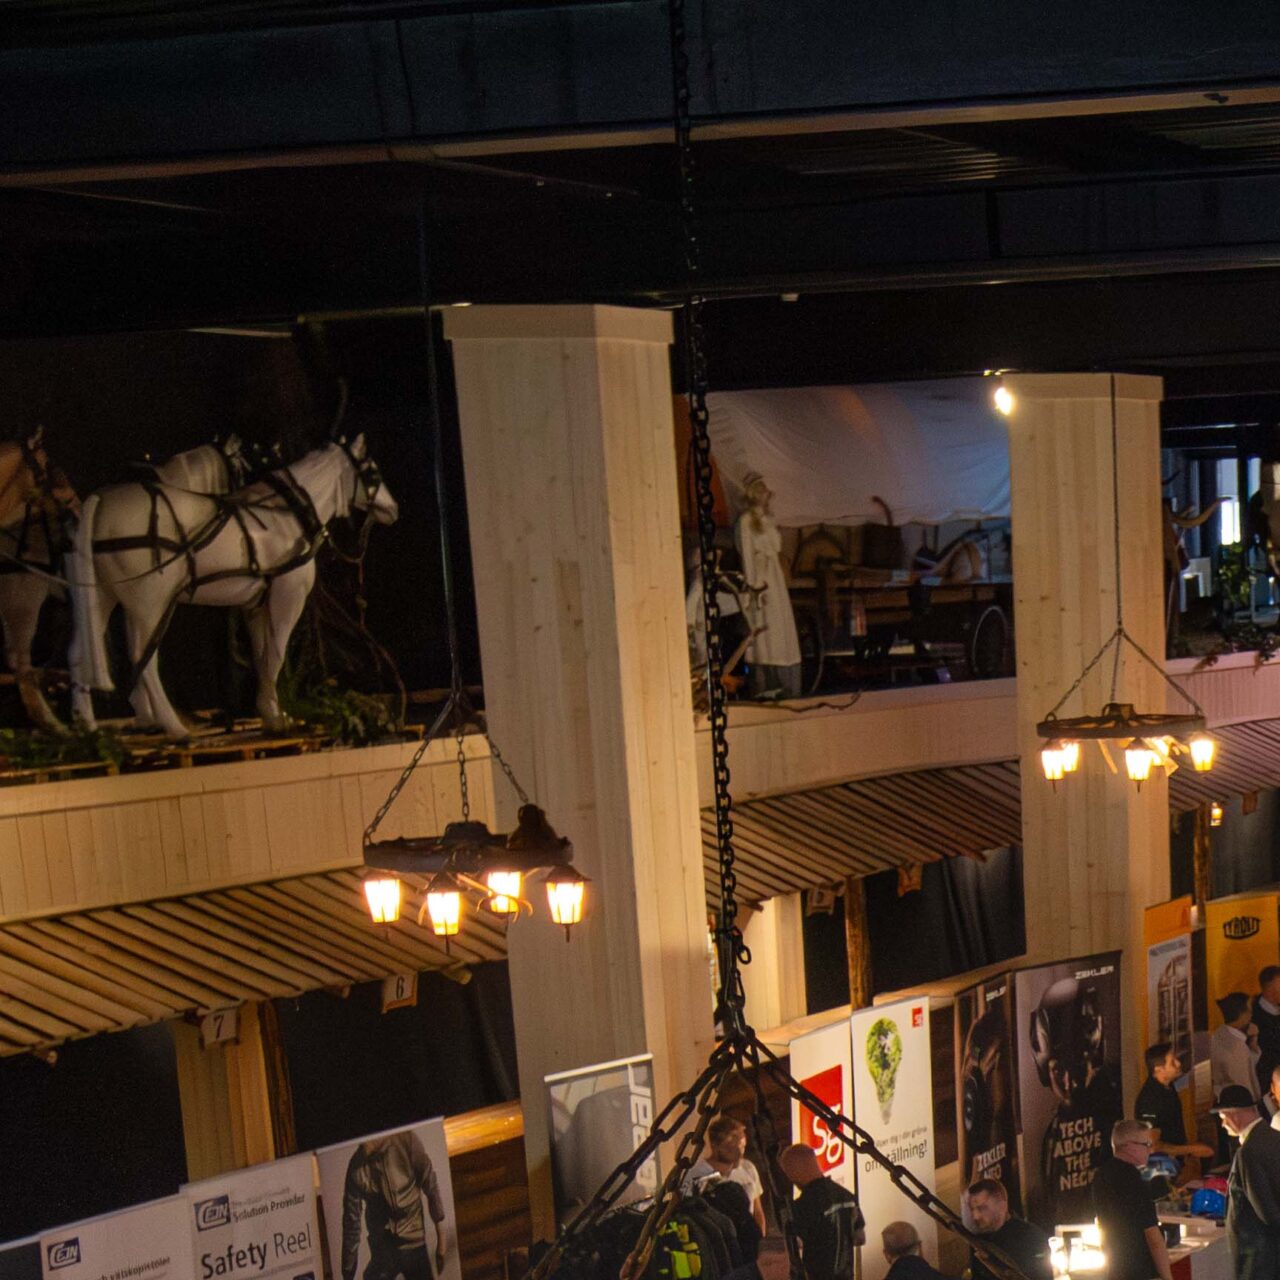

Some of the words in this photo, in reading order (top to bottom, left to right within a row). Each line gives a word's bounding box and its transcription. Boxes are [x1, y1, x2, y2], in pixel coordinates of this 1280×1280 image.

[213, 1014, 225, 1039] 7
[1060, 1117, 1094, 1139] TECH
[1054, 1132, 1102, 1159] ABOVE
[1065, 1152, 1090, 1172] THE
[201, 1242, 267, 1280] Safety
[273, 1222, 311, 1258] Reel
